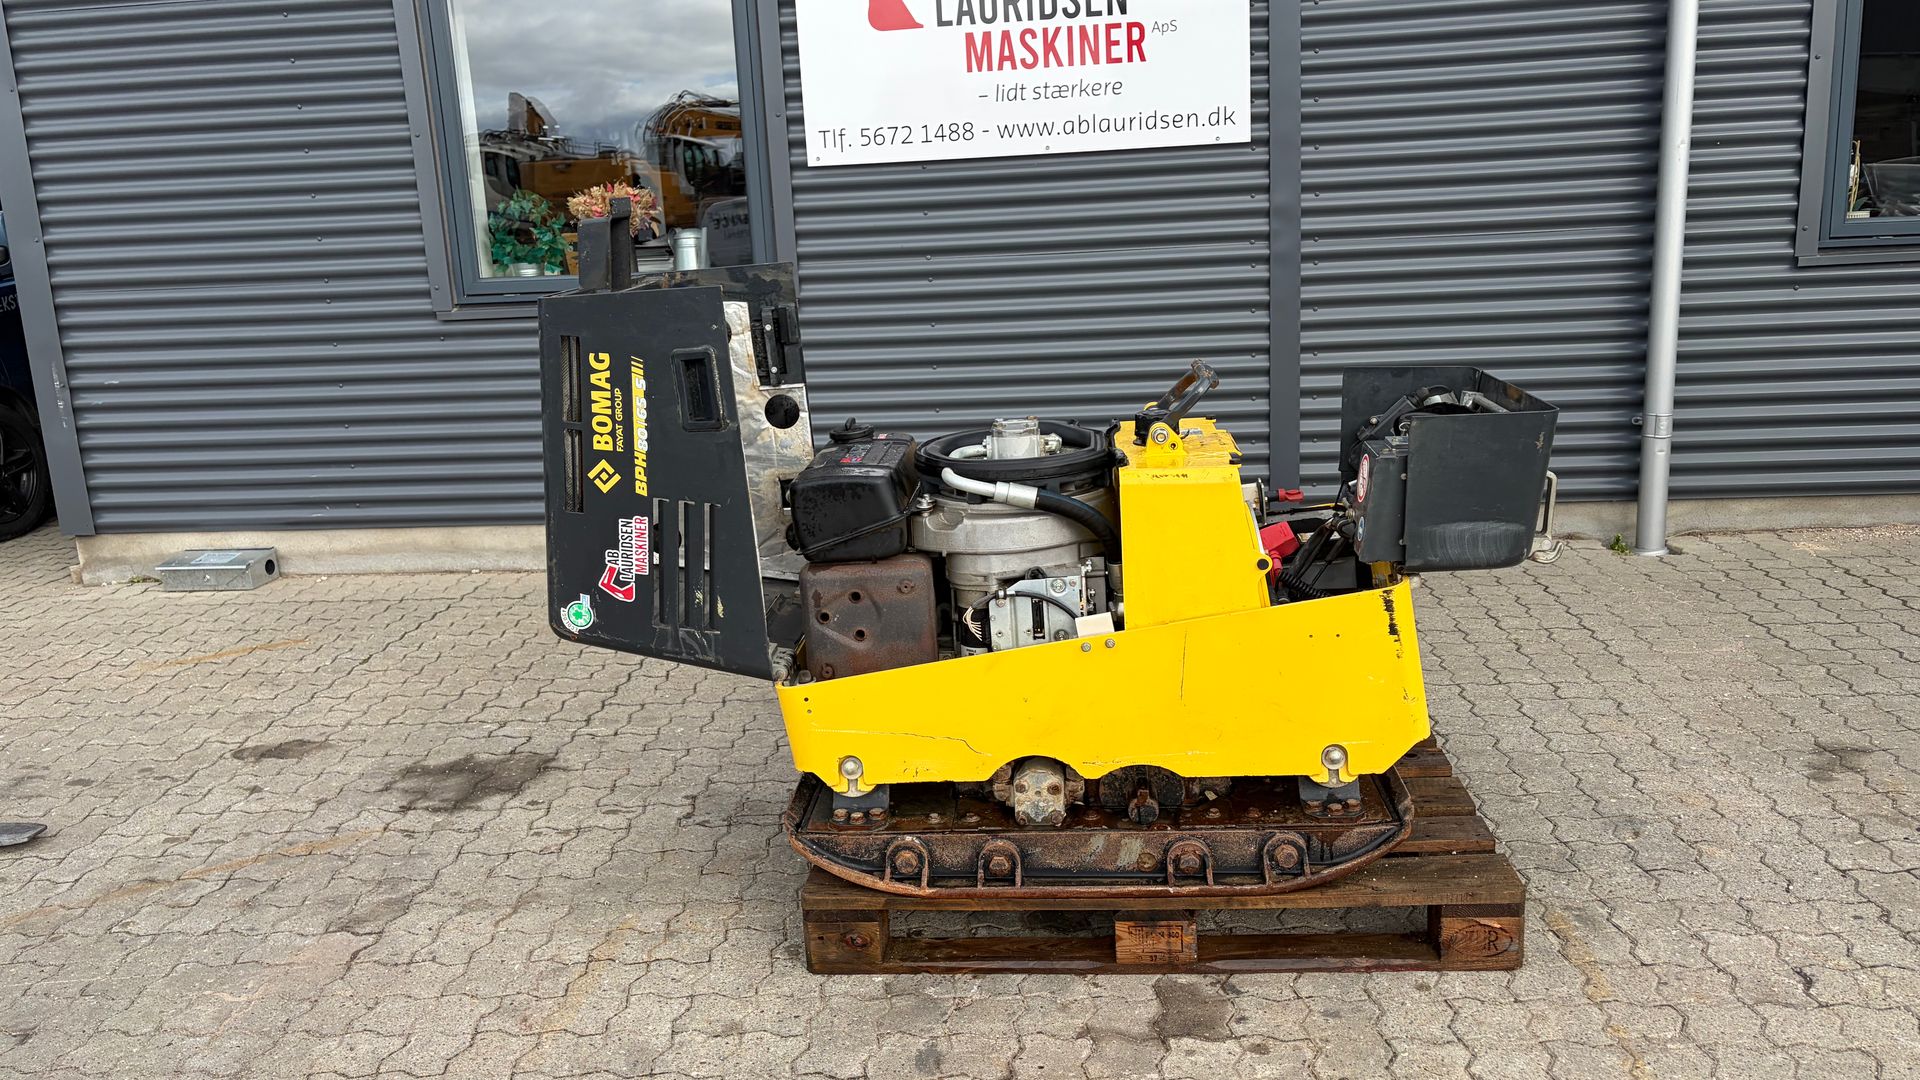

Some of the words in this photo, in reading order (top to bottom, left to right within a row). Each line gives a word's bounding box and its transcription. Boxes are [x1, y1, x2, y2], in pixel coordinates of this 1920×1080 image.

[964, 21, 1147, 73] MASKINER
[1151, 19, 1178, 36] ApS
[995, 82, 1027, 102] lidt
[1032, 78, 1123, 100] stærkere
[817, 127, 852, 153] Tlf.
[860, 125, 914, 147] 5672
[920, 122, 975, 144] 1488
[996, 105, 1237, 139] www.ablauridsen.dk
[588, 352, 614, 451] BOMAG
[614, 387, 624, 422] GROUP
[616, 423, 624, 452] FAYAT
[606, 550, 620, 566] AB
[620, 519, 634, 581] LAURIDSEN
[634, 517, 648, 574] MASKINER
